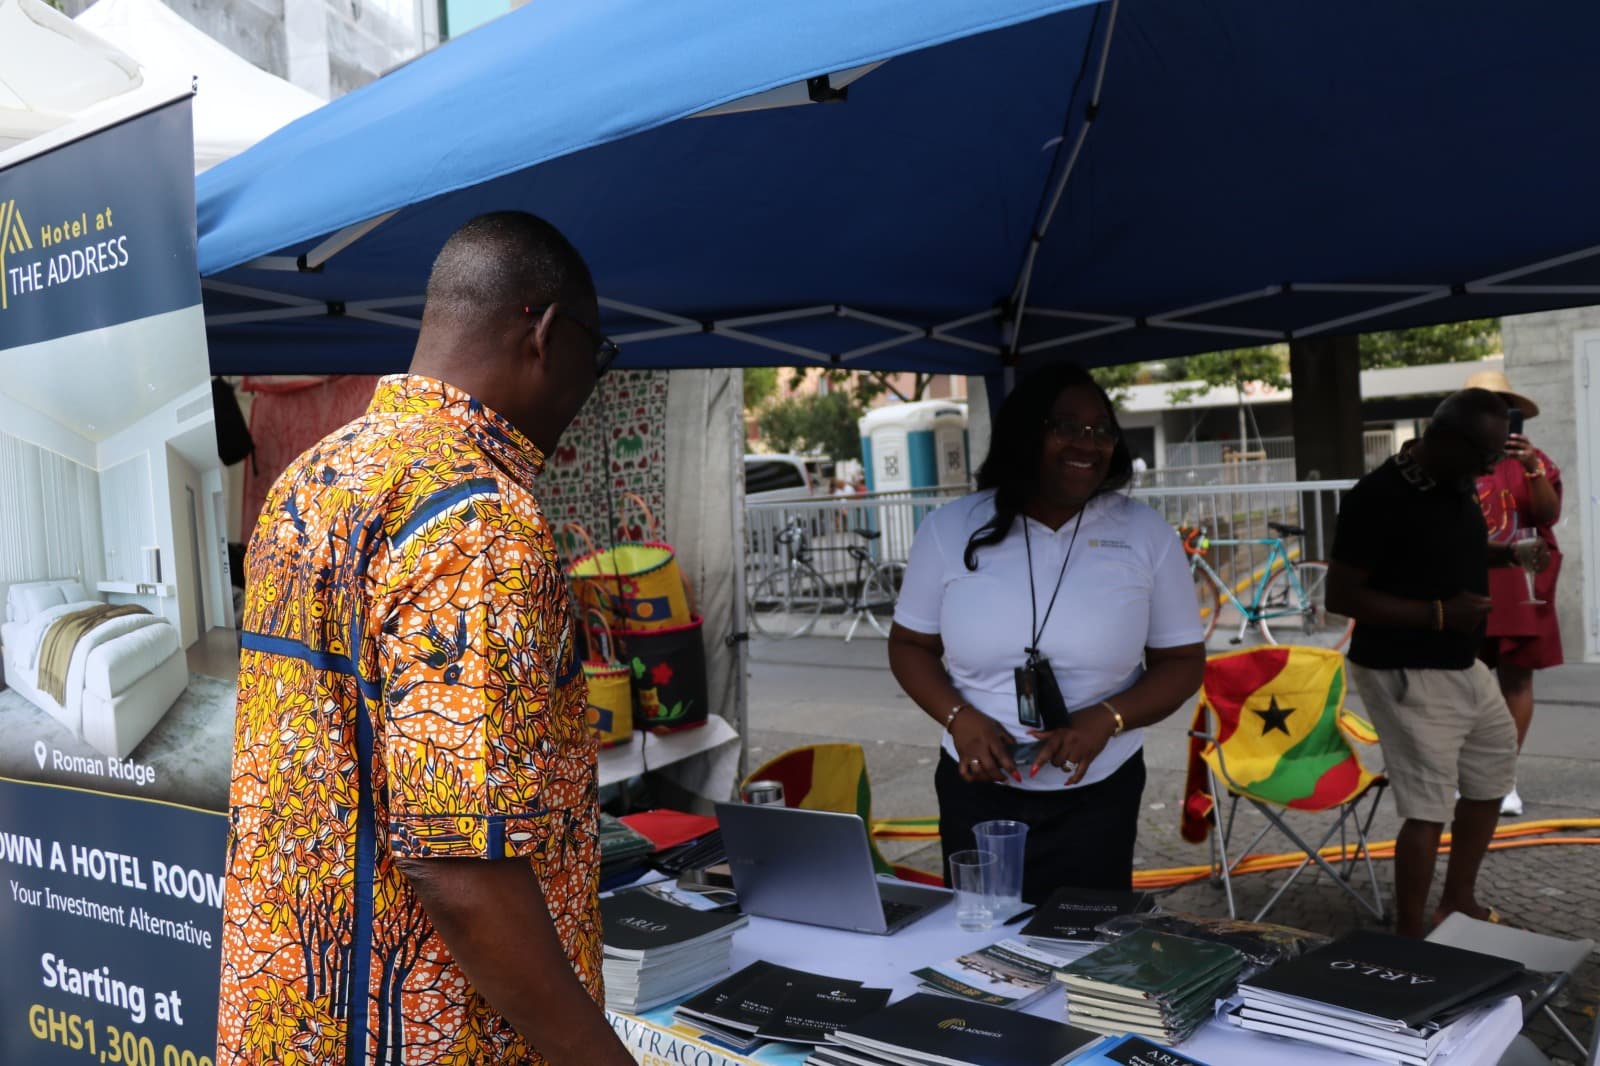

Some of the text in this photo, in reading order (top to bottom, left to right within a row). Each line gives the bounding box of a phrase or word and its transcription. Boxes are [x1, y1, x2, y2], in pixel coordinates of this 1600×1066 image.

[41, 206, 113, 248] Hotel at
[9, 235, 129, 296] THE ADDRESS
[52, 749, 156, 787] Roman Ridge
[0, 831, 225, 910] WN A HOTEL ROOM
[10, 879, 212, 950] Your Investment Alternative
[620, 917, 667, 931] ARLO
[41, 952, 184, 1026] Starting at
[1329, 961, 1436, 984] ARLO
[1147, 1050, 1193, 1066] ARL
